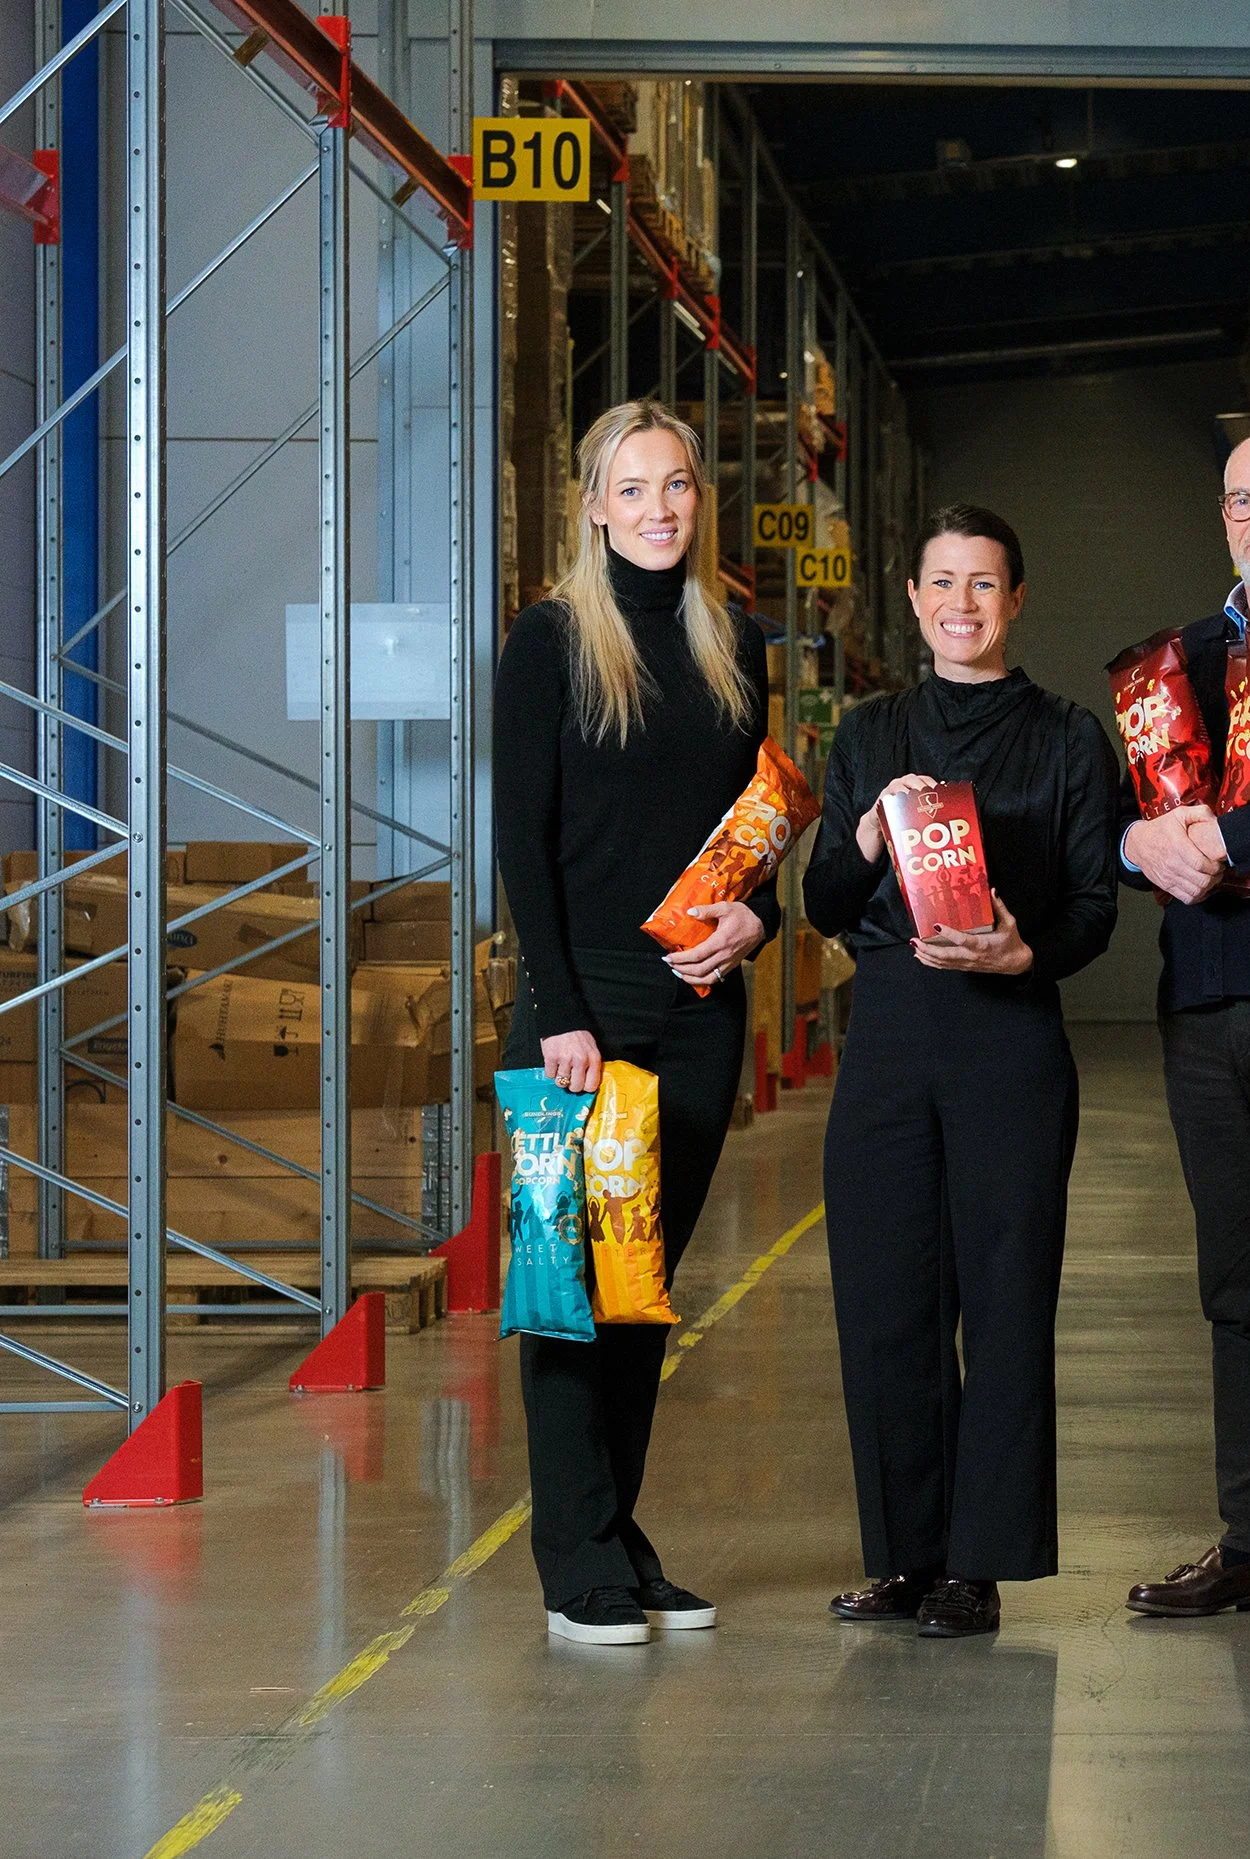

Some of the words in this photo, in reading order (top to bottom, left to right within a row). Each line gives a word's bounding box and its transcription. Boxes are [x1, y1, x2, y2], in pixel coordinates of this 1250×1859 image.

[482, 129, 581, 190] B10
[758, 510, 809, 542] C09
[800, 553, 847, 581] C10
[1127, 724, 1171, 765] ORN
[1144, 799, 1181, 820] LTED
[901, 818, 970, 856] POP
[906, 845, 976, 875] CORN
[515, 1243, 558, 1255] WEET
[516, 1255, 570, 1267] SALTY
[596, 1247, 649, 1257] UTTER
